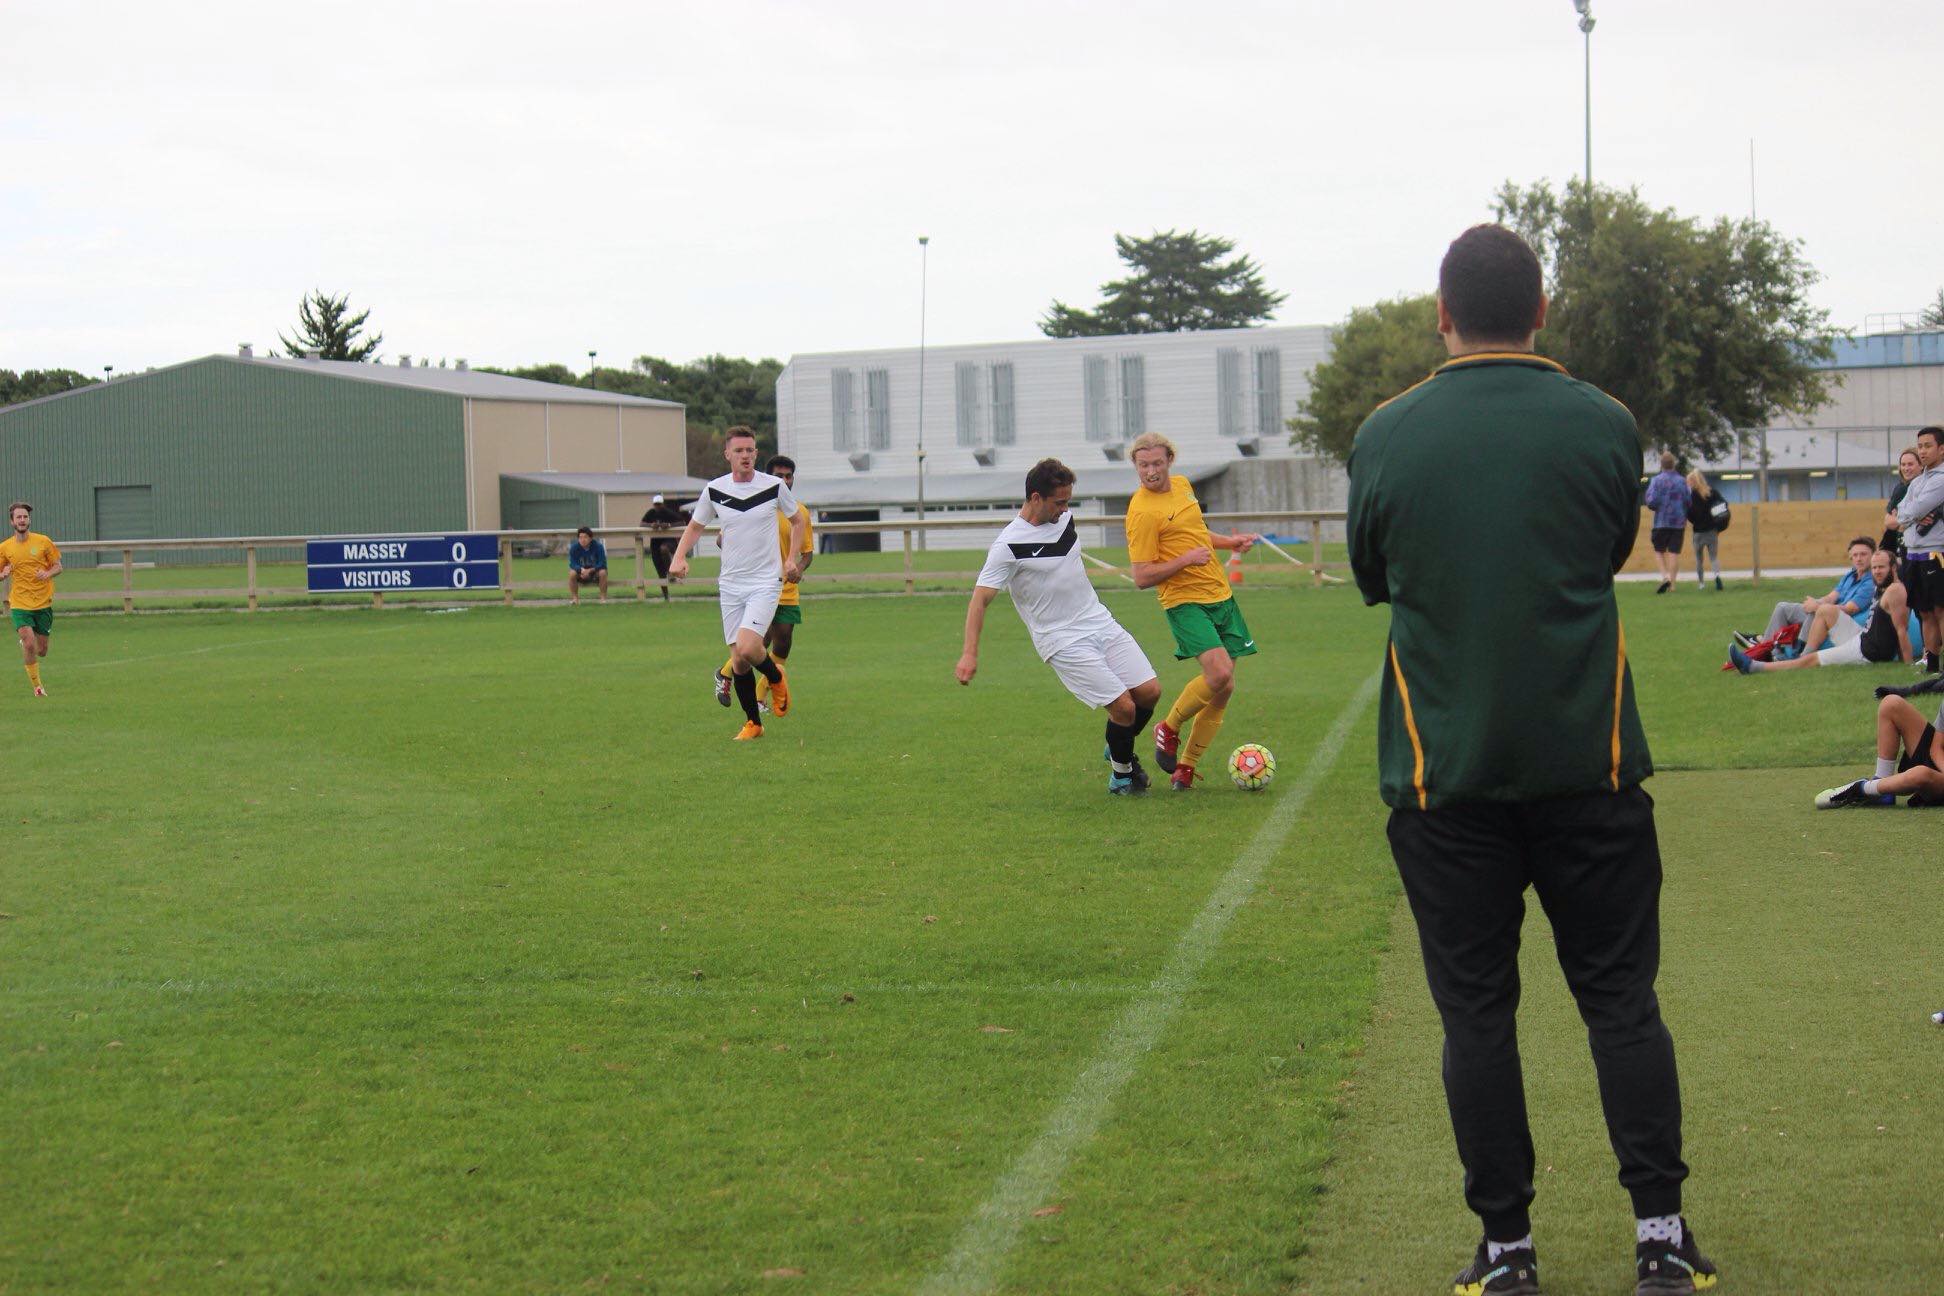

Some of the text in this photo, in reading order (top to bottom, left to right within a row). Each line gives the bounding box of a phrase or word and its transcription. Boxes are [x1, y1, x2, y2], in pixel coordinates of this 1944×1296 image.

[343, 542, 467, 562] MASSEY 0
[342, 568, 468, 588] VISITORS 0
